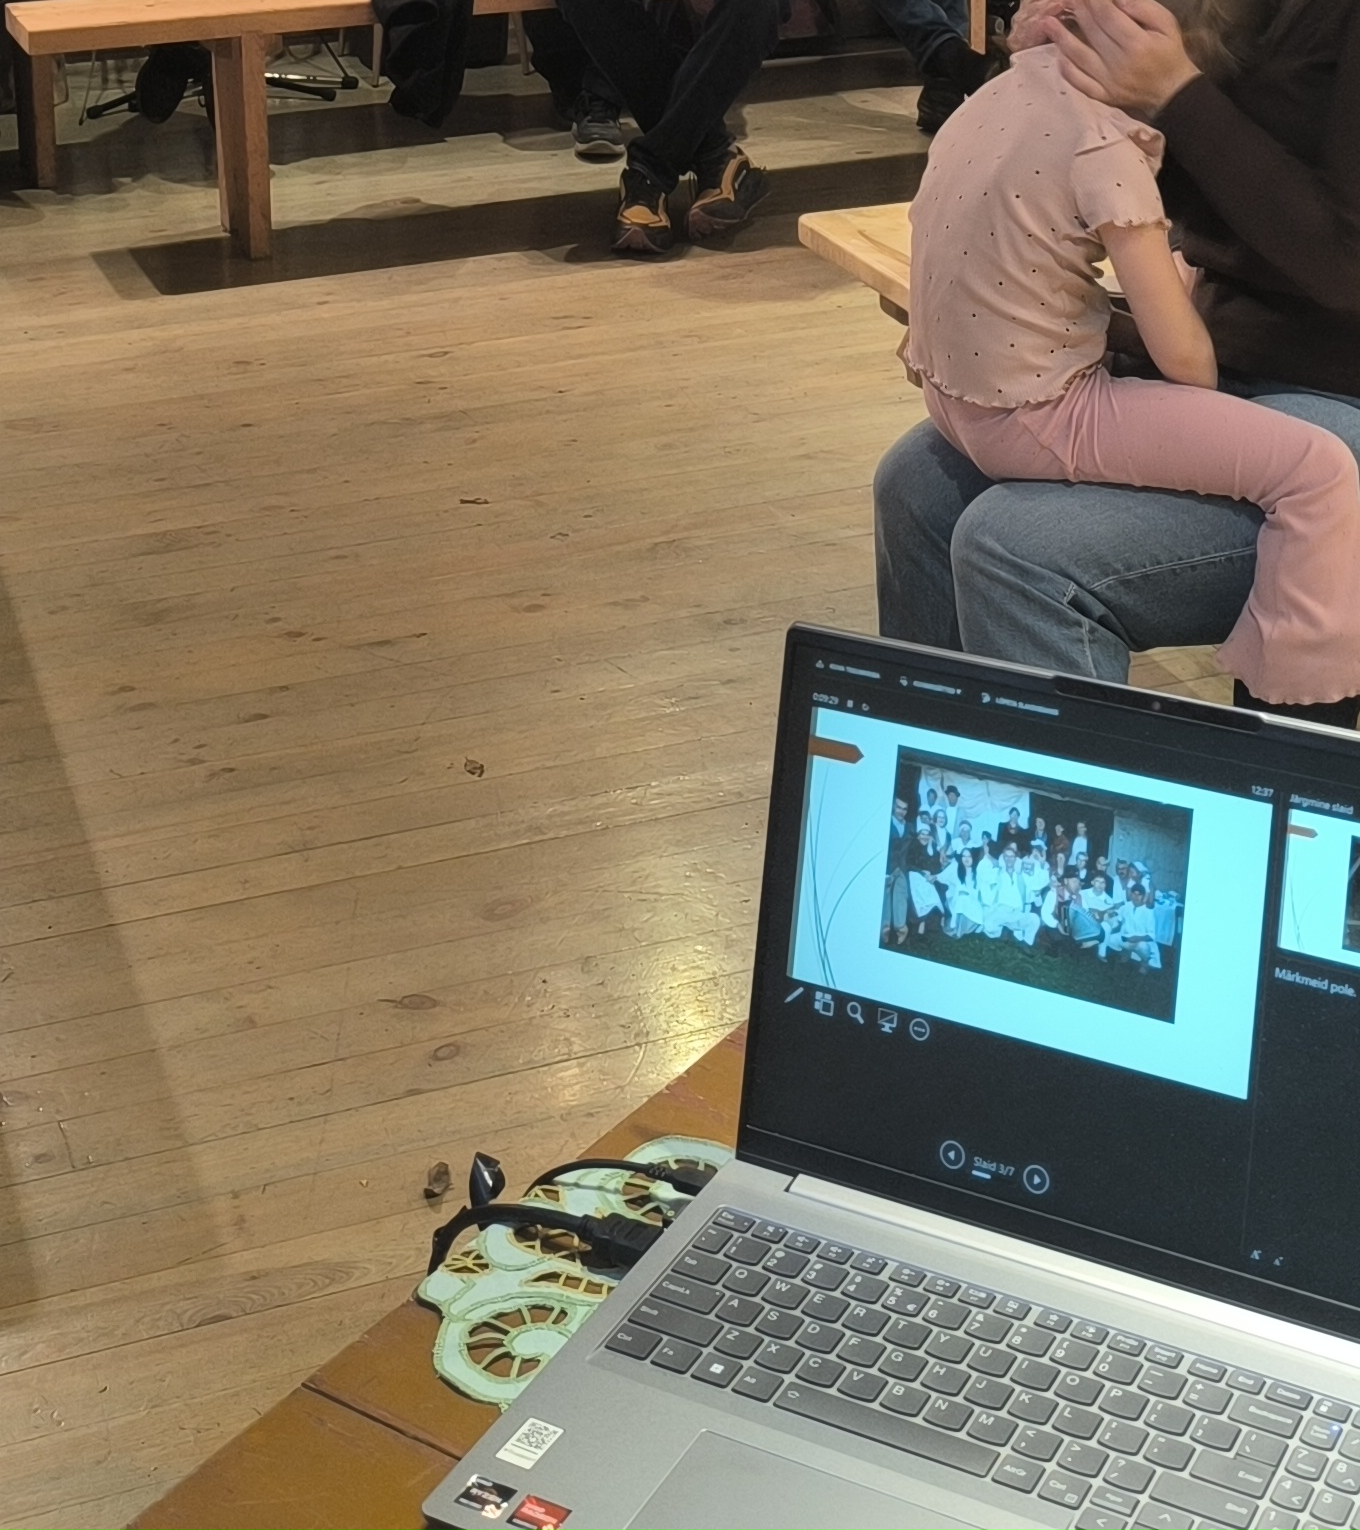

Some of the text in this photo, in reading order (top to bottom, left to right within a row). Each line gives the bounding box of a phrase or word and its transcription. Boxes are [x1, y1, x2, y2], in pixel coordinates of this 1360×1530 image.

[1251, 784, 1275, 798] 12:37
[1274, 966, 1357, 998] Märkmeid pole.
[725, 1329, 997, 1426] Z X C V B N M
[727, 1298, 1073, 1418] A S D F G H J K L
[775, 1280, 792, 1292] W
[812, 1293, 826, 1304] E
[853, 1306, 867, 1317] R
[897, 1319, 909, 1330] T
[939, 1333, 951, 1343] Y
[978, 1346, 993, 1357] U
[1109, 1388, 1123, 1398] P
